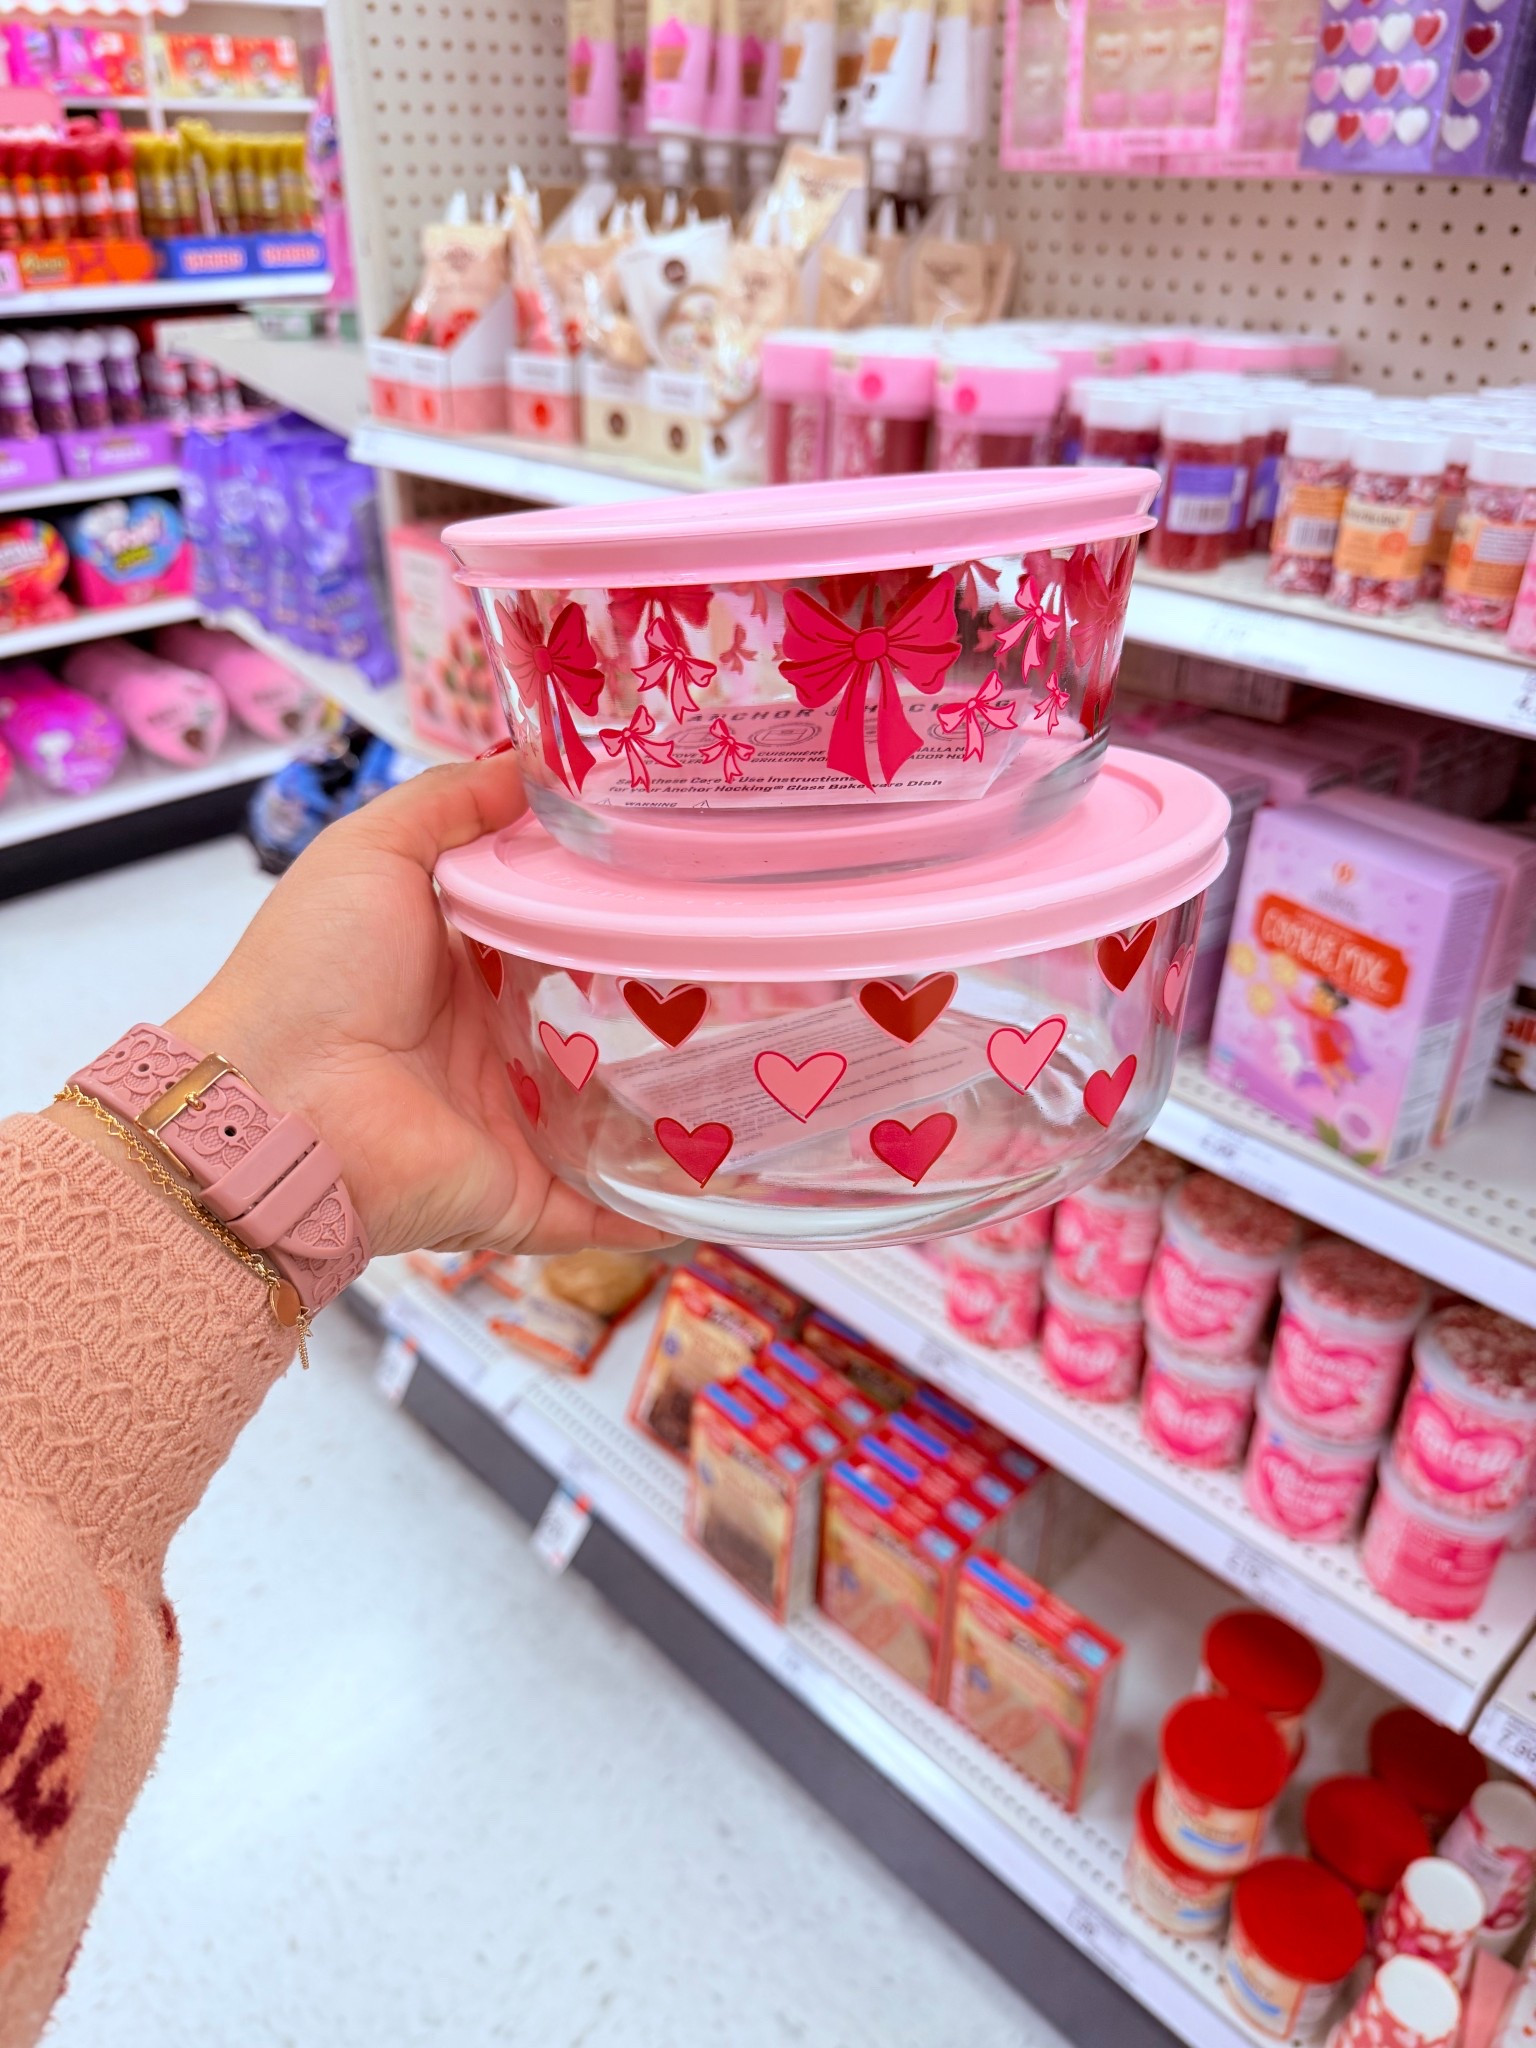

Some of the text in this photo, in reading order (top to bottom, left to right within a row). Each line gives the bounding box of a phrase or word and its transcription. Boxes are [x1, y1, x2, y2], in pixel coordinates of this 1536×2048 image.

[687, 709, 815, 722] ANCHOR
[651, 777, 688, 785] these
[690, 777, 721, 785] Care
[738, 775, 766, 784] Use
[661, 785, 713, 793] Anchor
[907, 779, 943, 787] Dish
